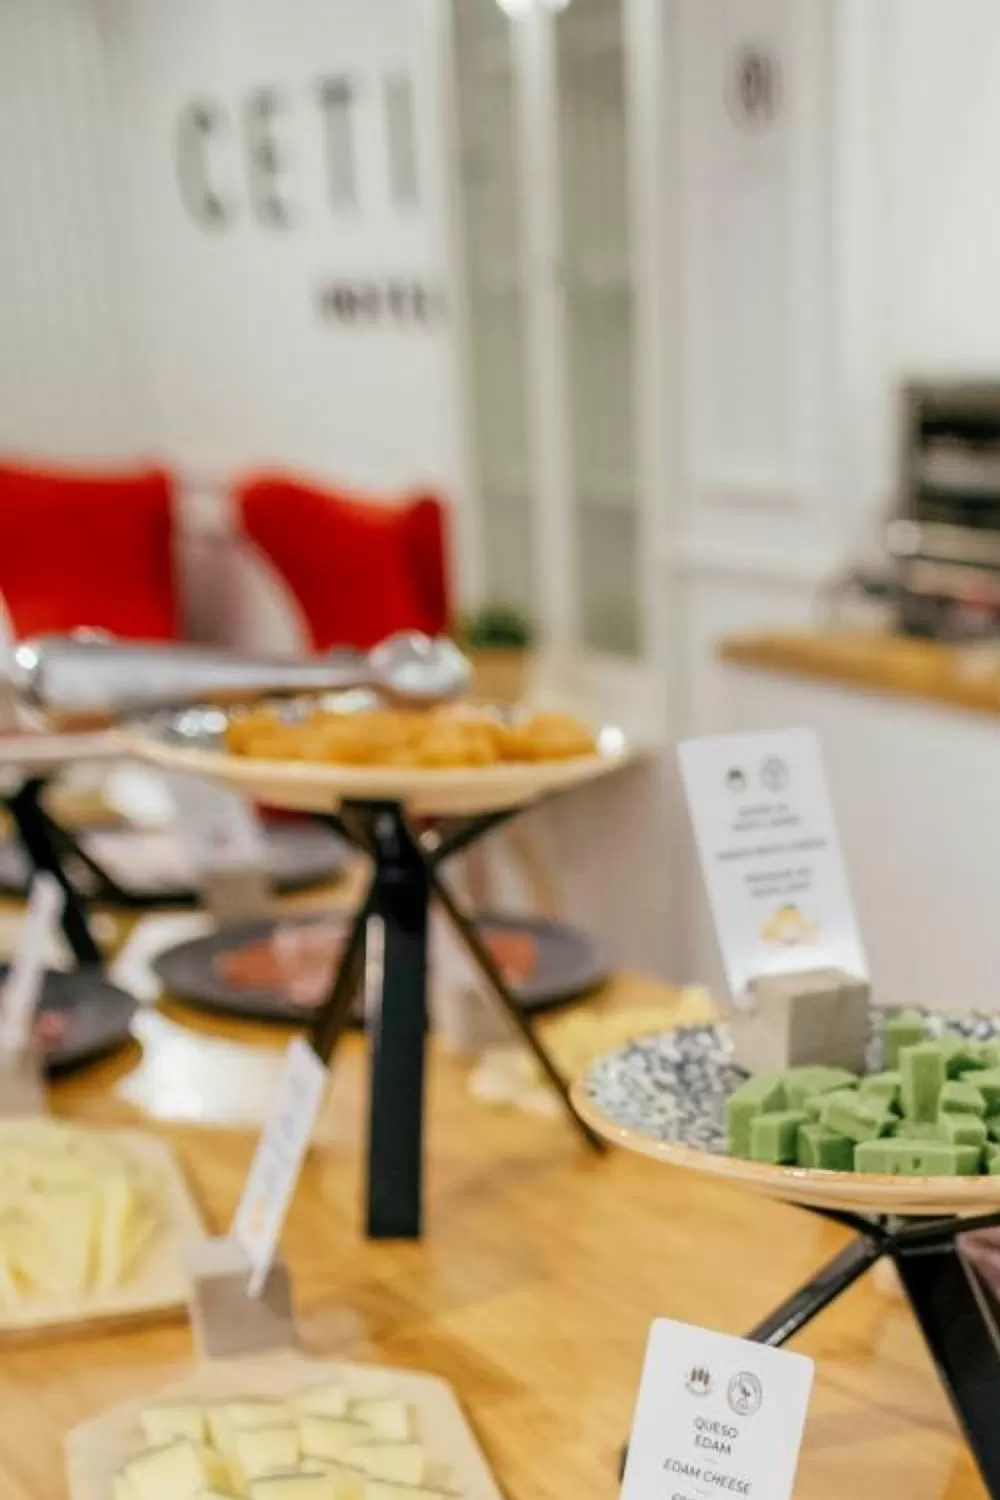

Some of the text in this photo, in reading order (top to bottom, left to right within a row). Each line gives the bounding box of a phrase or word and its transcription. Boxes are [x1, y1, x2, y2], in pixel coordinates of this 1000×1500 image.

[694, 1416, 739, 1439] QUESO
[694, 1434, 732, 1455] EDAM
[663, 1457, 752, 1495] EDAM CHEESE
